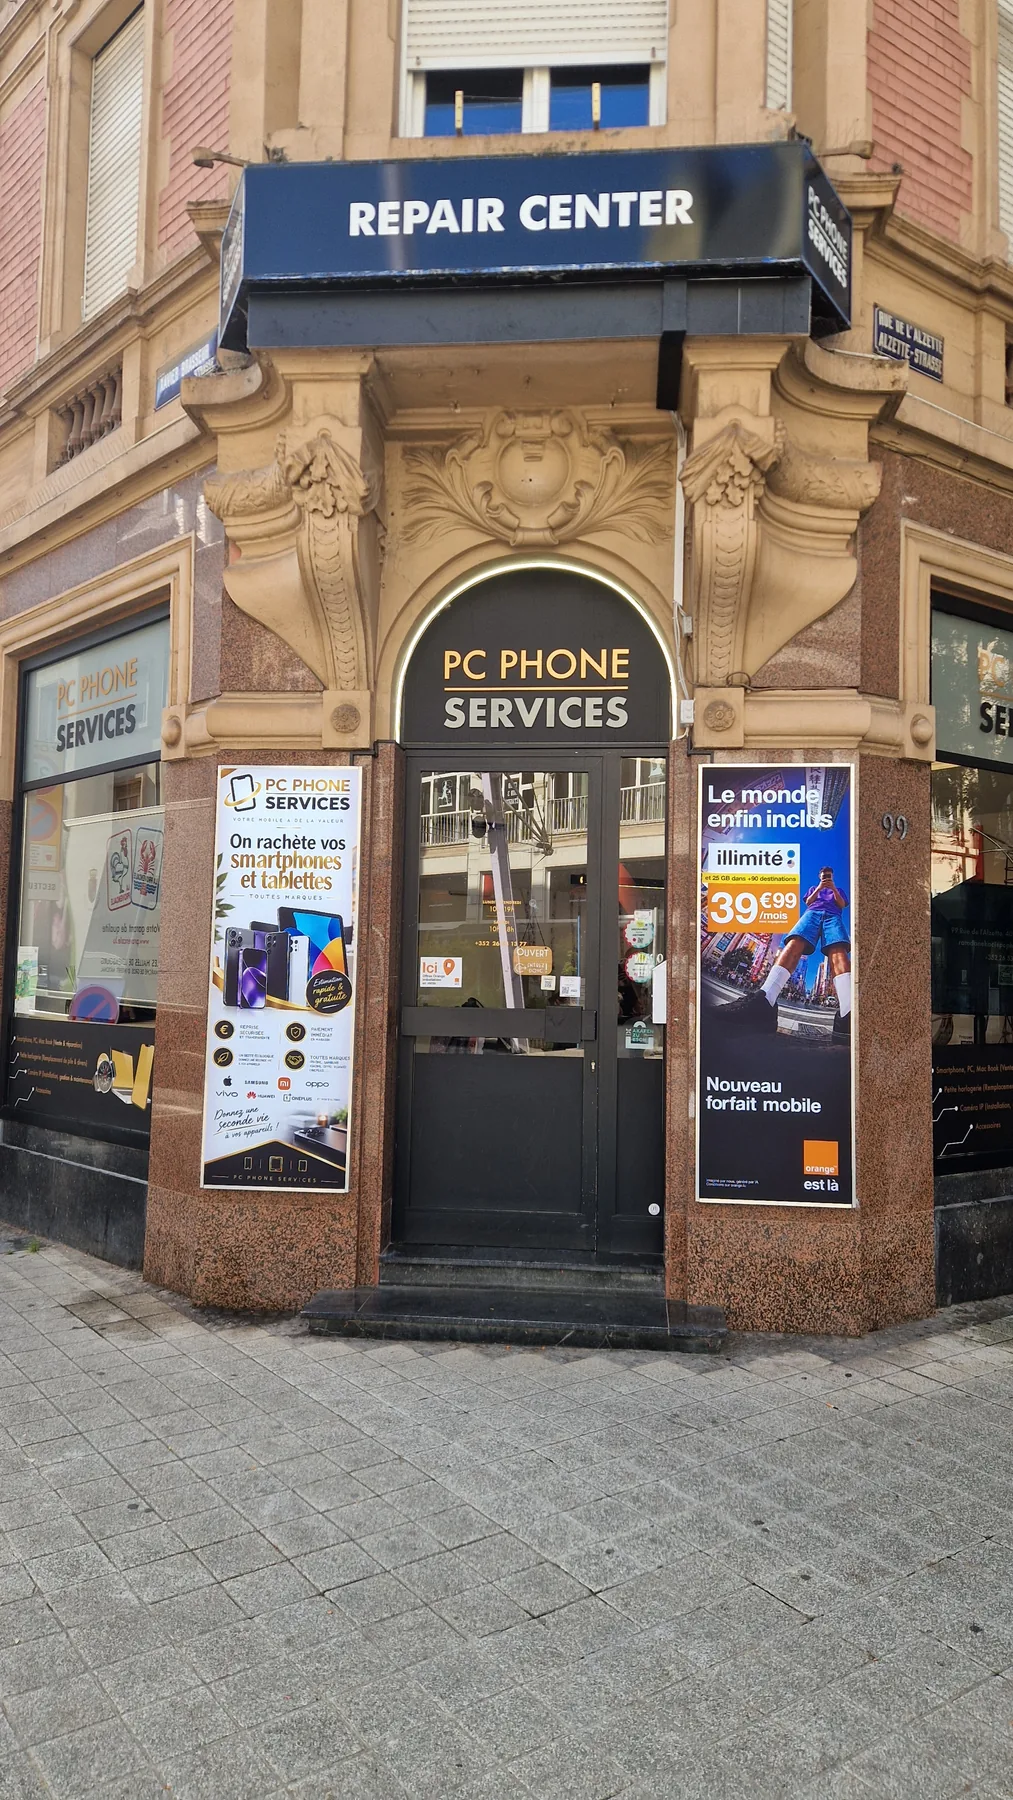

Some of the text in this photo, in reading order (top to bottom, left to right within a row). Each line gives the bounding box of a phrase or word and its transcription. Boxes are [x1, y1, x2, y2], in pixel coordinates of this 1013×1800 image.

[349, 189, 694, 236] REPAIR CENTER
[808, 185, 848, 261] PC PHONE
[808, 218, 847, 289] SERVICES
[878, 310, 894, 330] RUE
[896, 320, 904, 334] DE
[444, 648, 630, 680] PC PHONE
[977, 651, 1005, 687] PC
[57, 657, 138, 710] PC PHONE
[443, 696, 629, 729] SERVICES
[56, 703, 136, 752] SERVICES
[266, 778, 351, 792] PC PHONE
[265, 796, 351, 811] SERVICES
[708, 785, 735, 803] Le
[741, 785, 819, 804] monde
[707, 809, 833, 828] enfin inclus
[881, 811, 909, 841] 99
[230, 833, 346, 851] On rachète vos
[230, 850, 342, 874] smartphones
[717, 849, 783, 866] illimité
[241, 870, 333, 891] et tablettes
[710, 891, 758, 925] 39
[759, 911, 788, 920] /mois
[516, 948, 548, 958] OUVERT
[422, 961, 437, 974] Ici
[312, 985, 336, 995] rapide
[313, 976, 344, 987] Estimation
[314, 991, 348, 1007] gratuite
[706, 1076, 782, 1093] Nouveau
[958, 1084, 982, 1094] horlogerie
[705, 1095, 822, 1113] forfait mobile
[214, 1108, 244, 1120] Donnez
[218, 1113, 270, 1132] seconde vie
[244, 1124, 273, 1138] appareils
[805, 1165, 835, 1174] orange
[804, 1179, 839, 1191] est là
